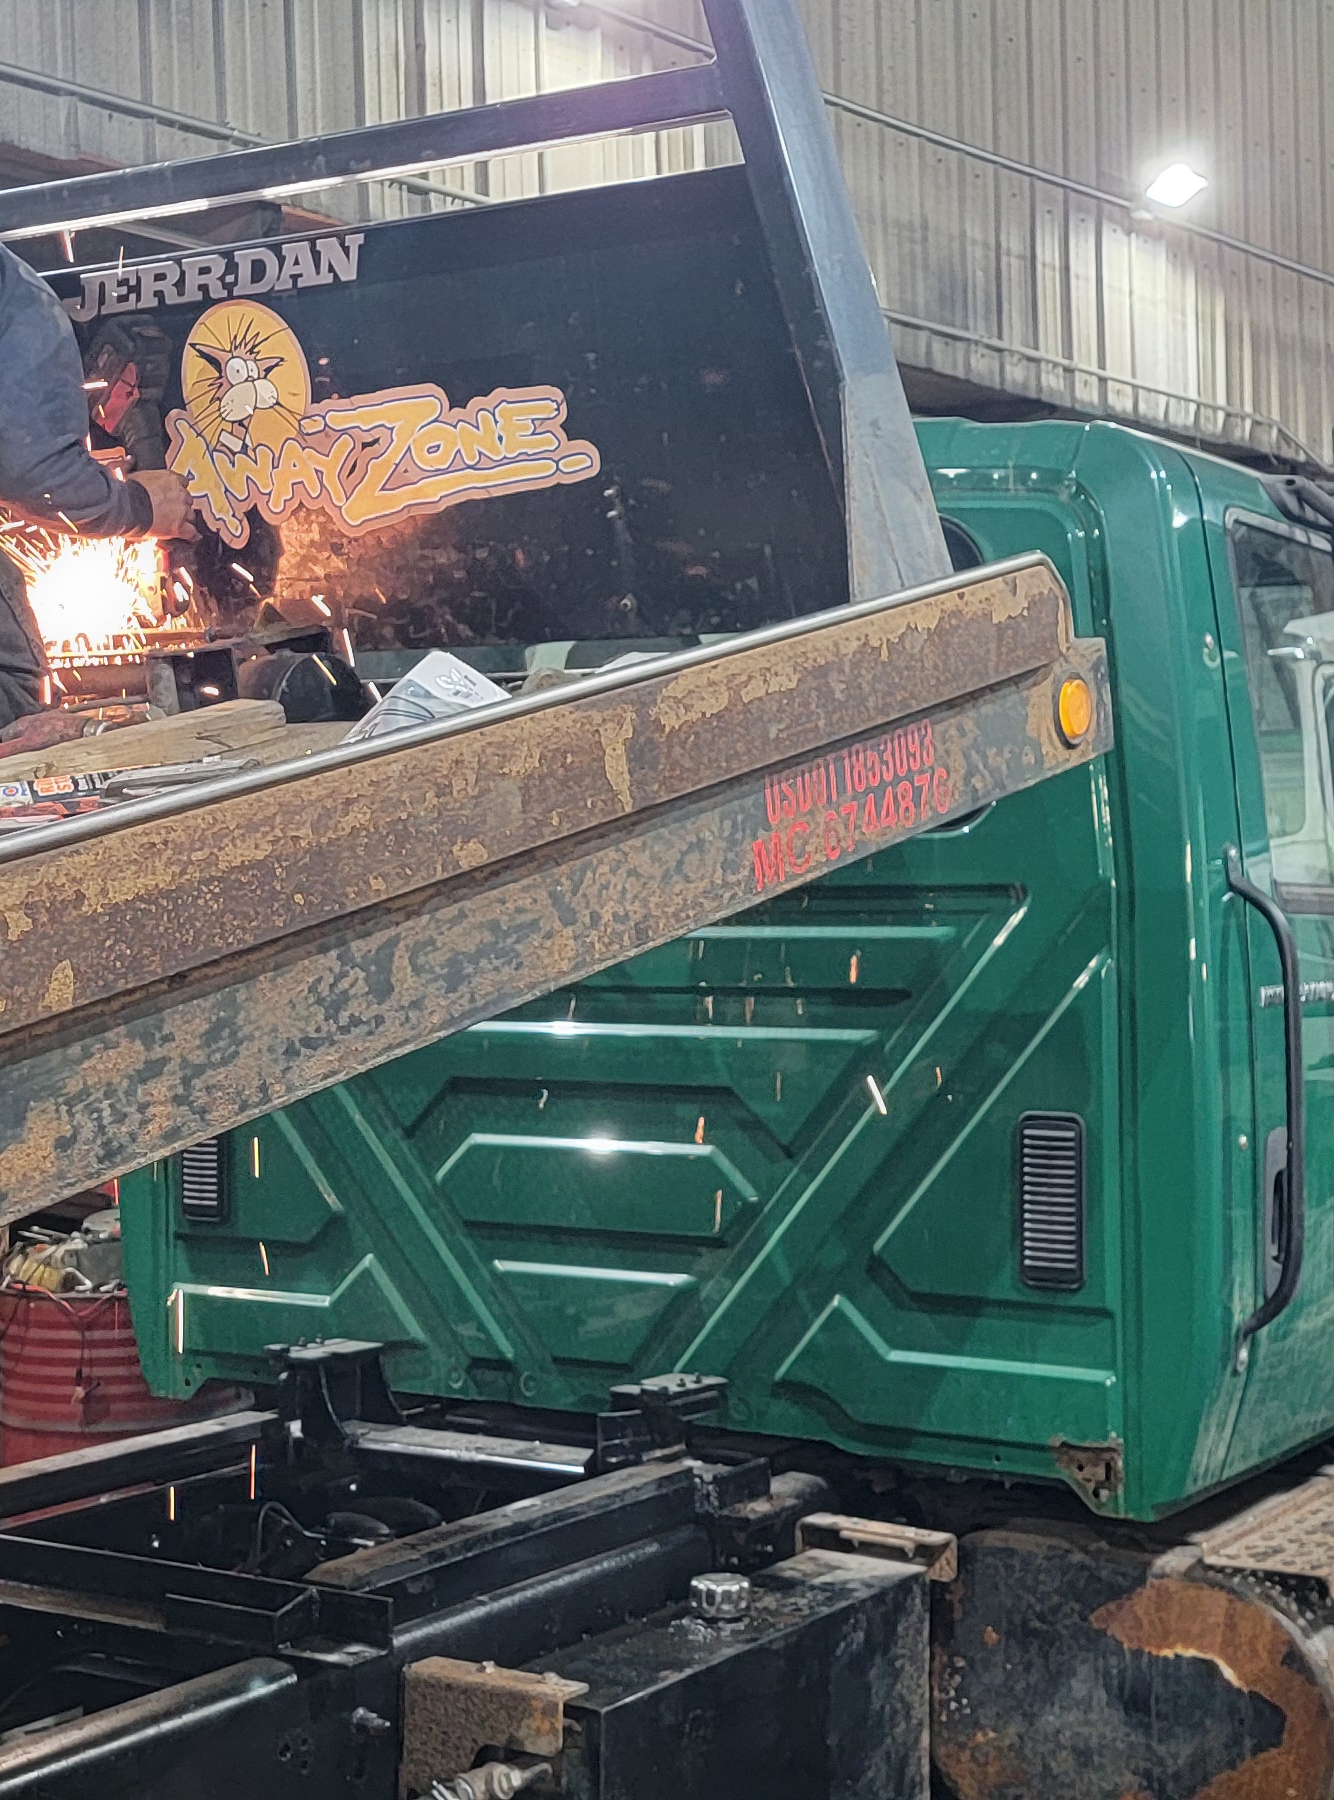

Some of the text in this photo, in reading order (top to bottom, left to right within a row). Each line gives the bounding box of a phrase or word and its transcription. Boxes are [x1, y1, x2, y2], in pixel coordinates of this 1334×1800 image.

[63, 234, 364, 322] JERR-DAN
[173, 396, 593, 535] AWAY ZONE
[841, 719, 934, 796] 1853093
[752, 821, 811, 892] MC
